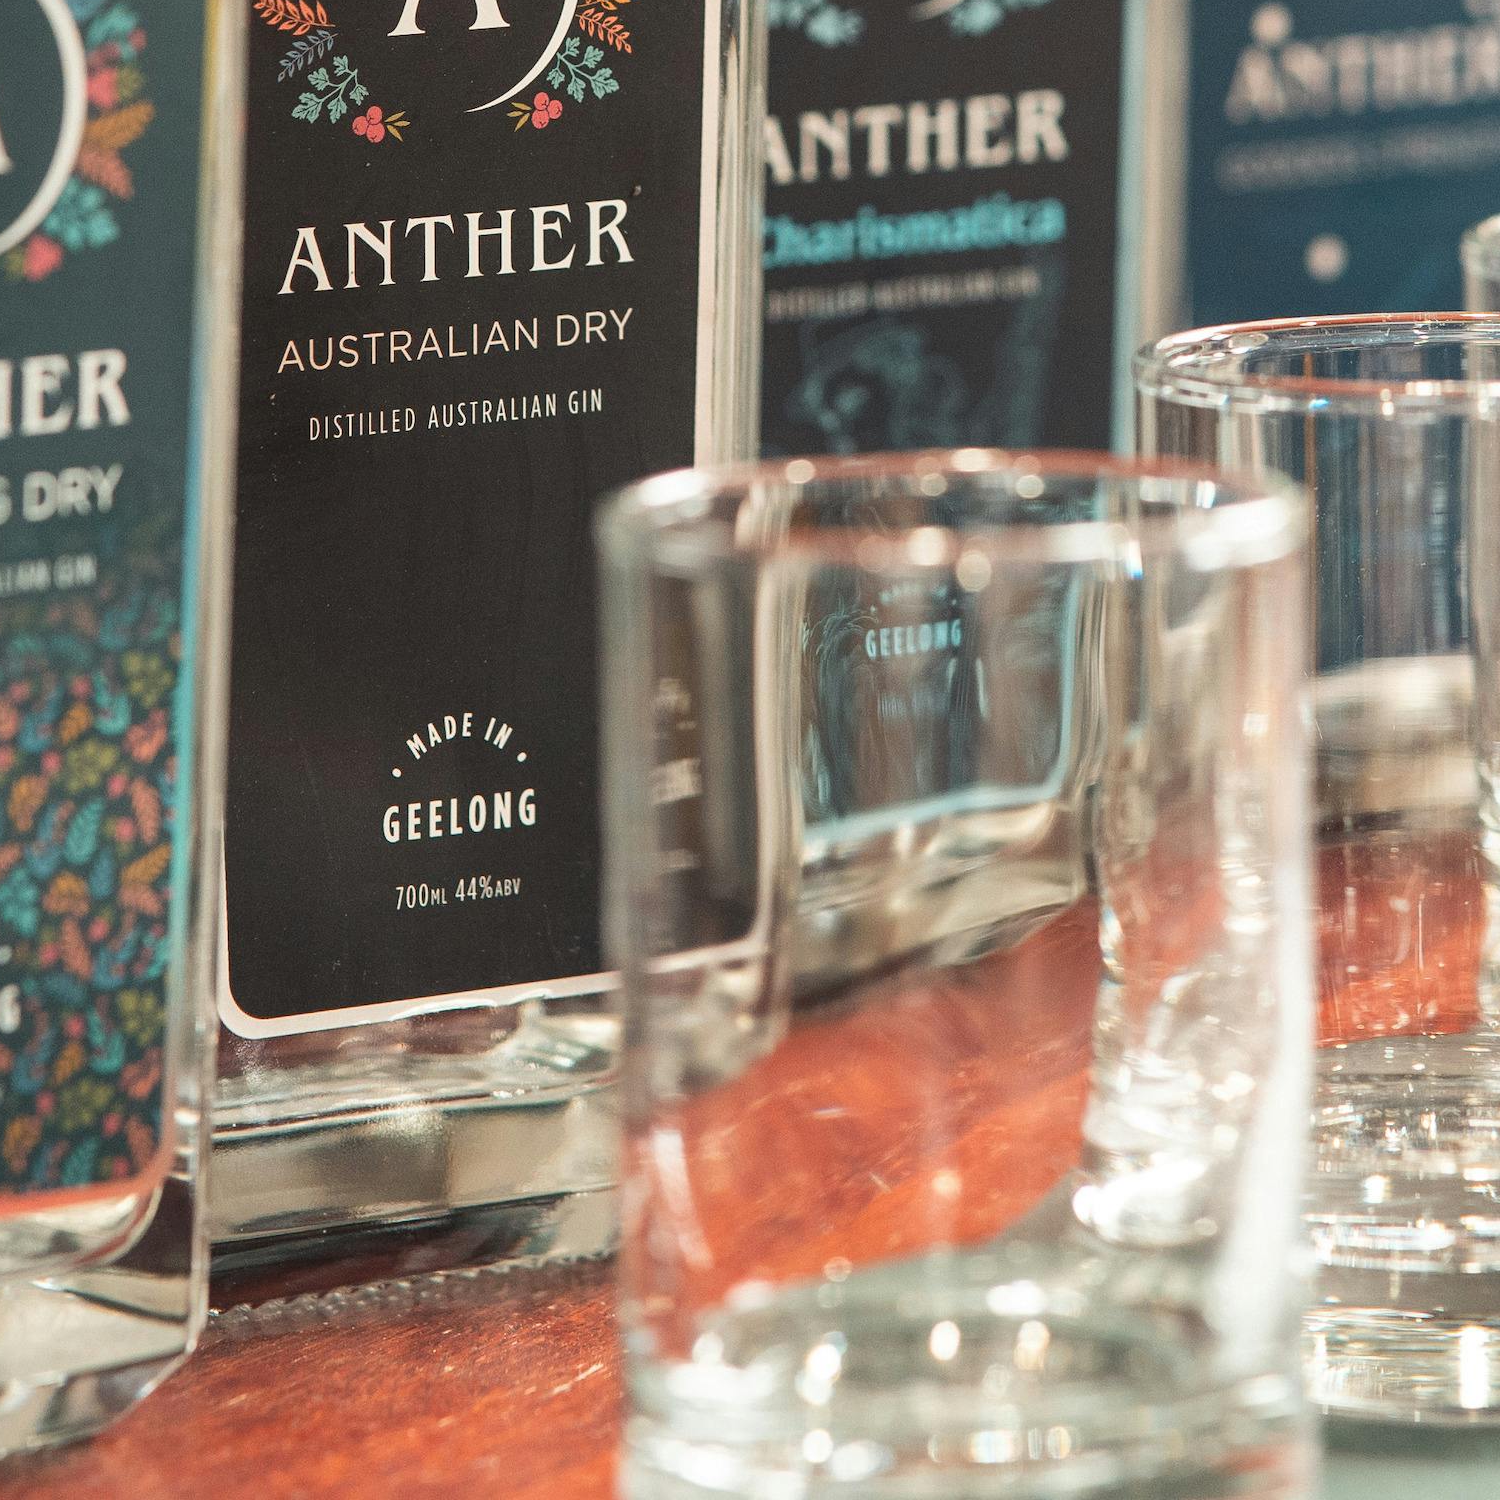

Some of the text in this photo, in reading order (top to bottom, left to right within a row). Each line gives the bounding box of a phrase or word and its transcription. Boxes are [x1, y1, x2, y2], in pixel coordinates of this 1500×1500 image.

[277, 198, 636, 295] ANTHER
[277, 307, 634, 374] AUSTRALIAN DRY
[309, 387, 603, 441] DISTILLED AUSTRALIAN GIN
[22, 461, 124, 523] DRY
[865, 617, 963, 660] GEELONG
[406, 712, 513, 760] MADE IN
[382, 787, 537, 844] GEELONG
[395, 874, 522, 911] 700ML 44%ABV
